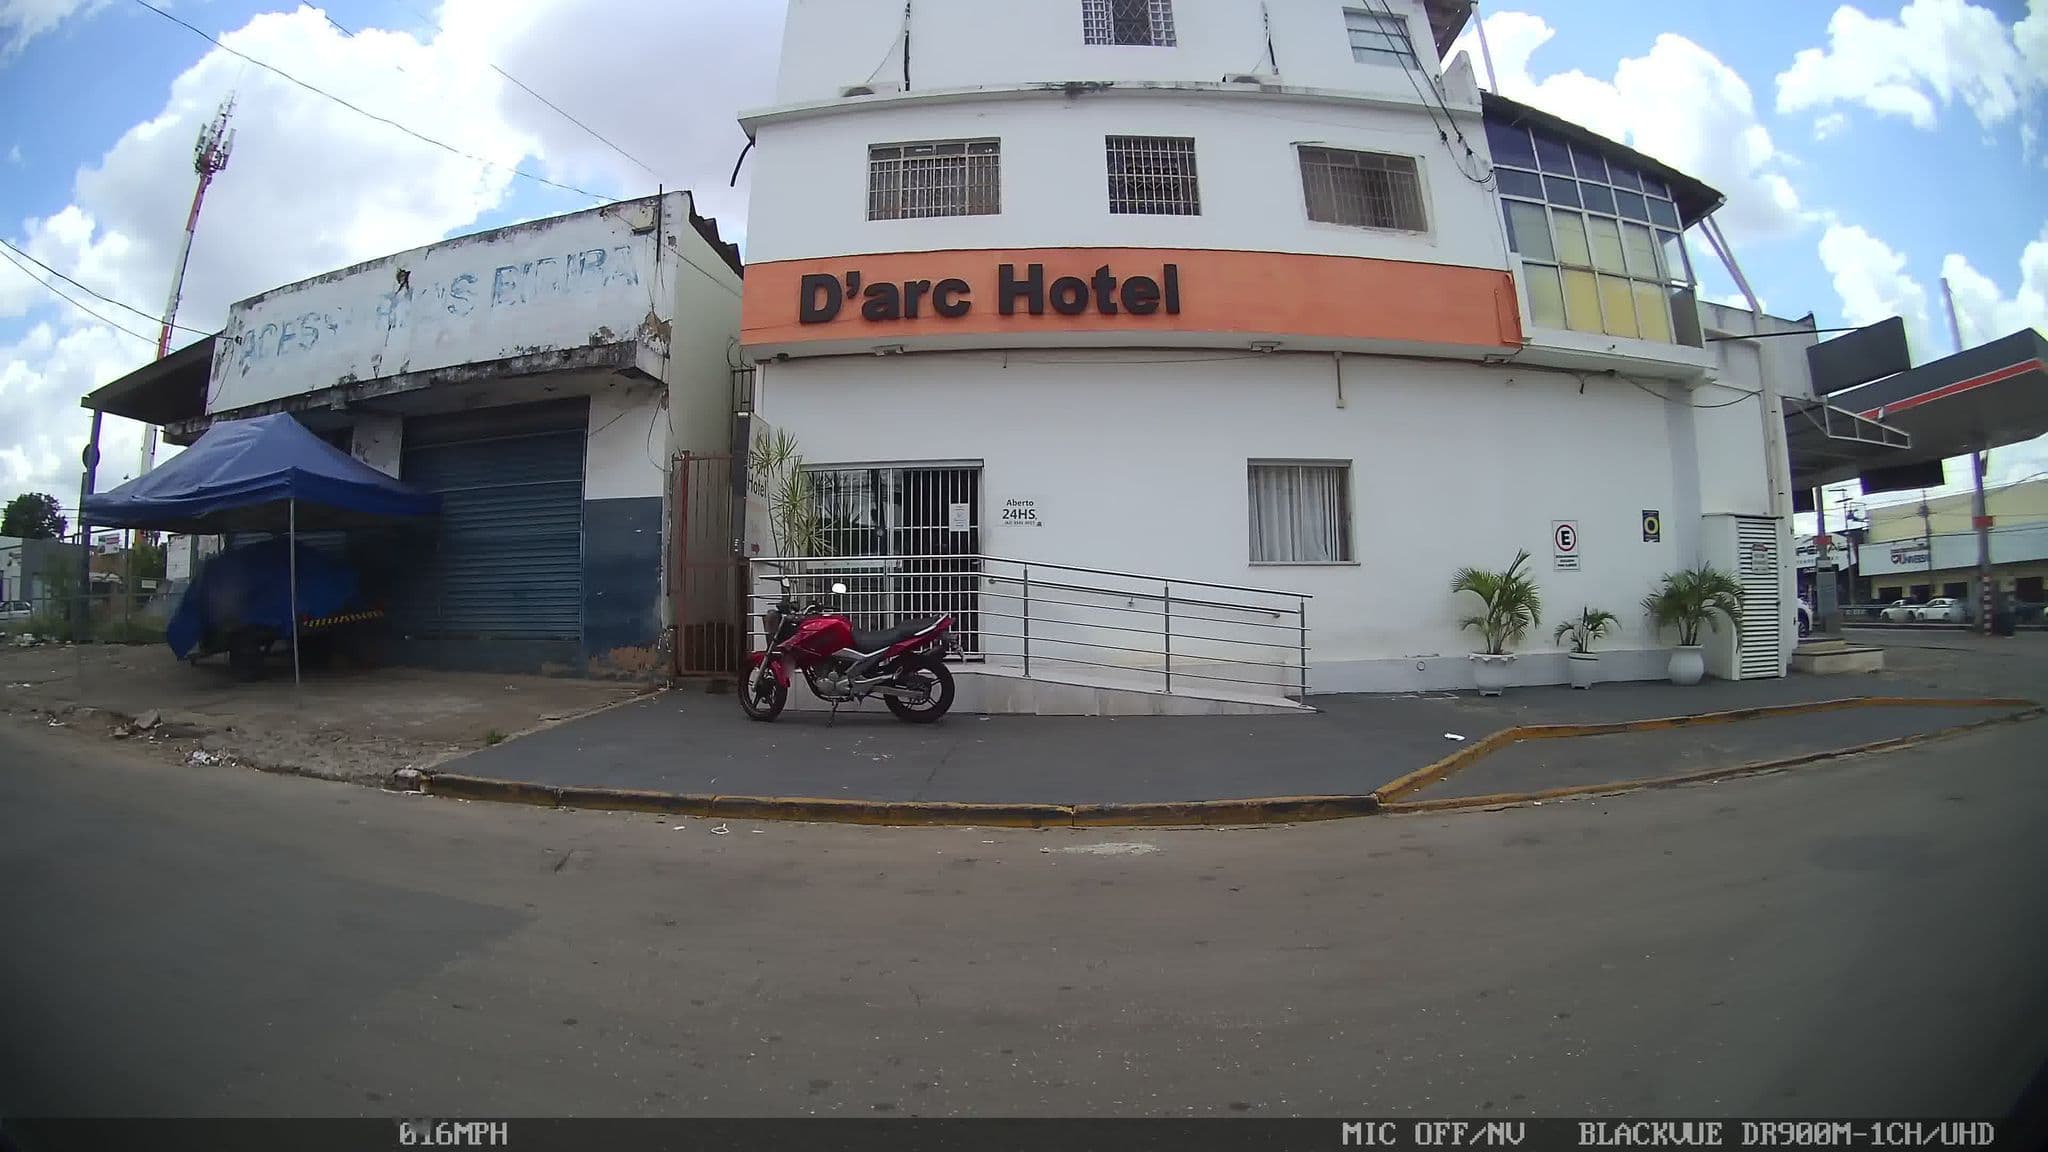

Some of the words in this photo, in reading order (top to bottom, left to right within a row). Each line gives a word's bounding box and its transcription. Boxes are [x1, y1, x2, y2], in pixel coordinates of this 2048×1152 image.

[801, 271, 971, 323] D'arc
[999, 263, 1180, 315] Hotel
[747, 473, 767, 498] Hotel
[1006, 498, 1034, 507] Aberto
[1561, 530, 1571, 546] E
